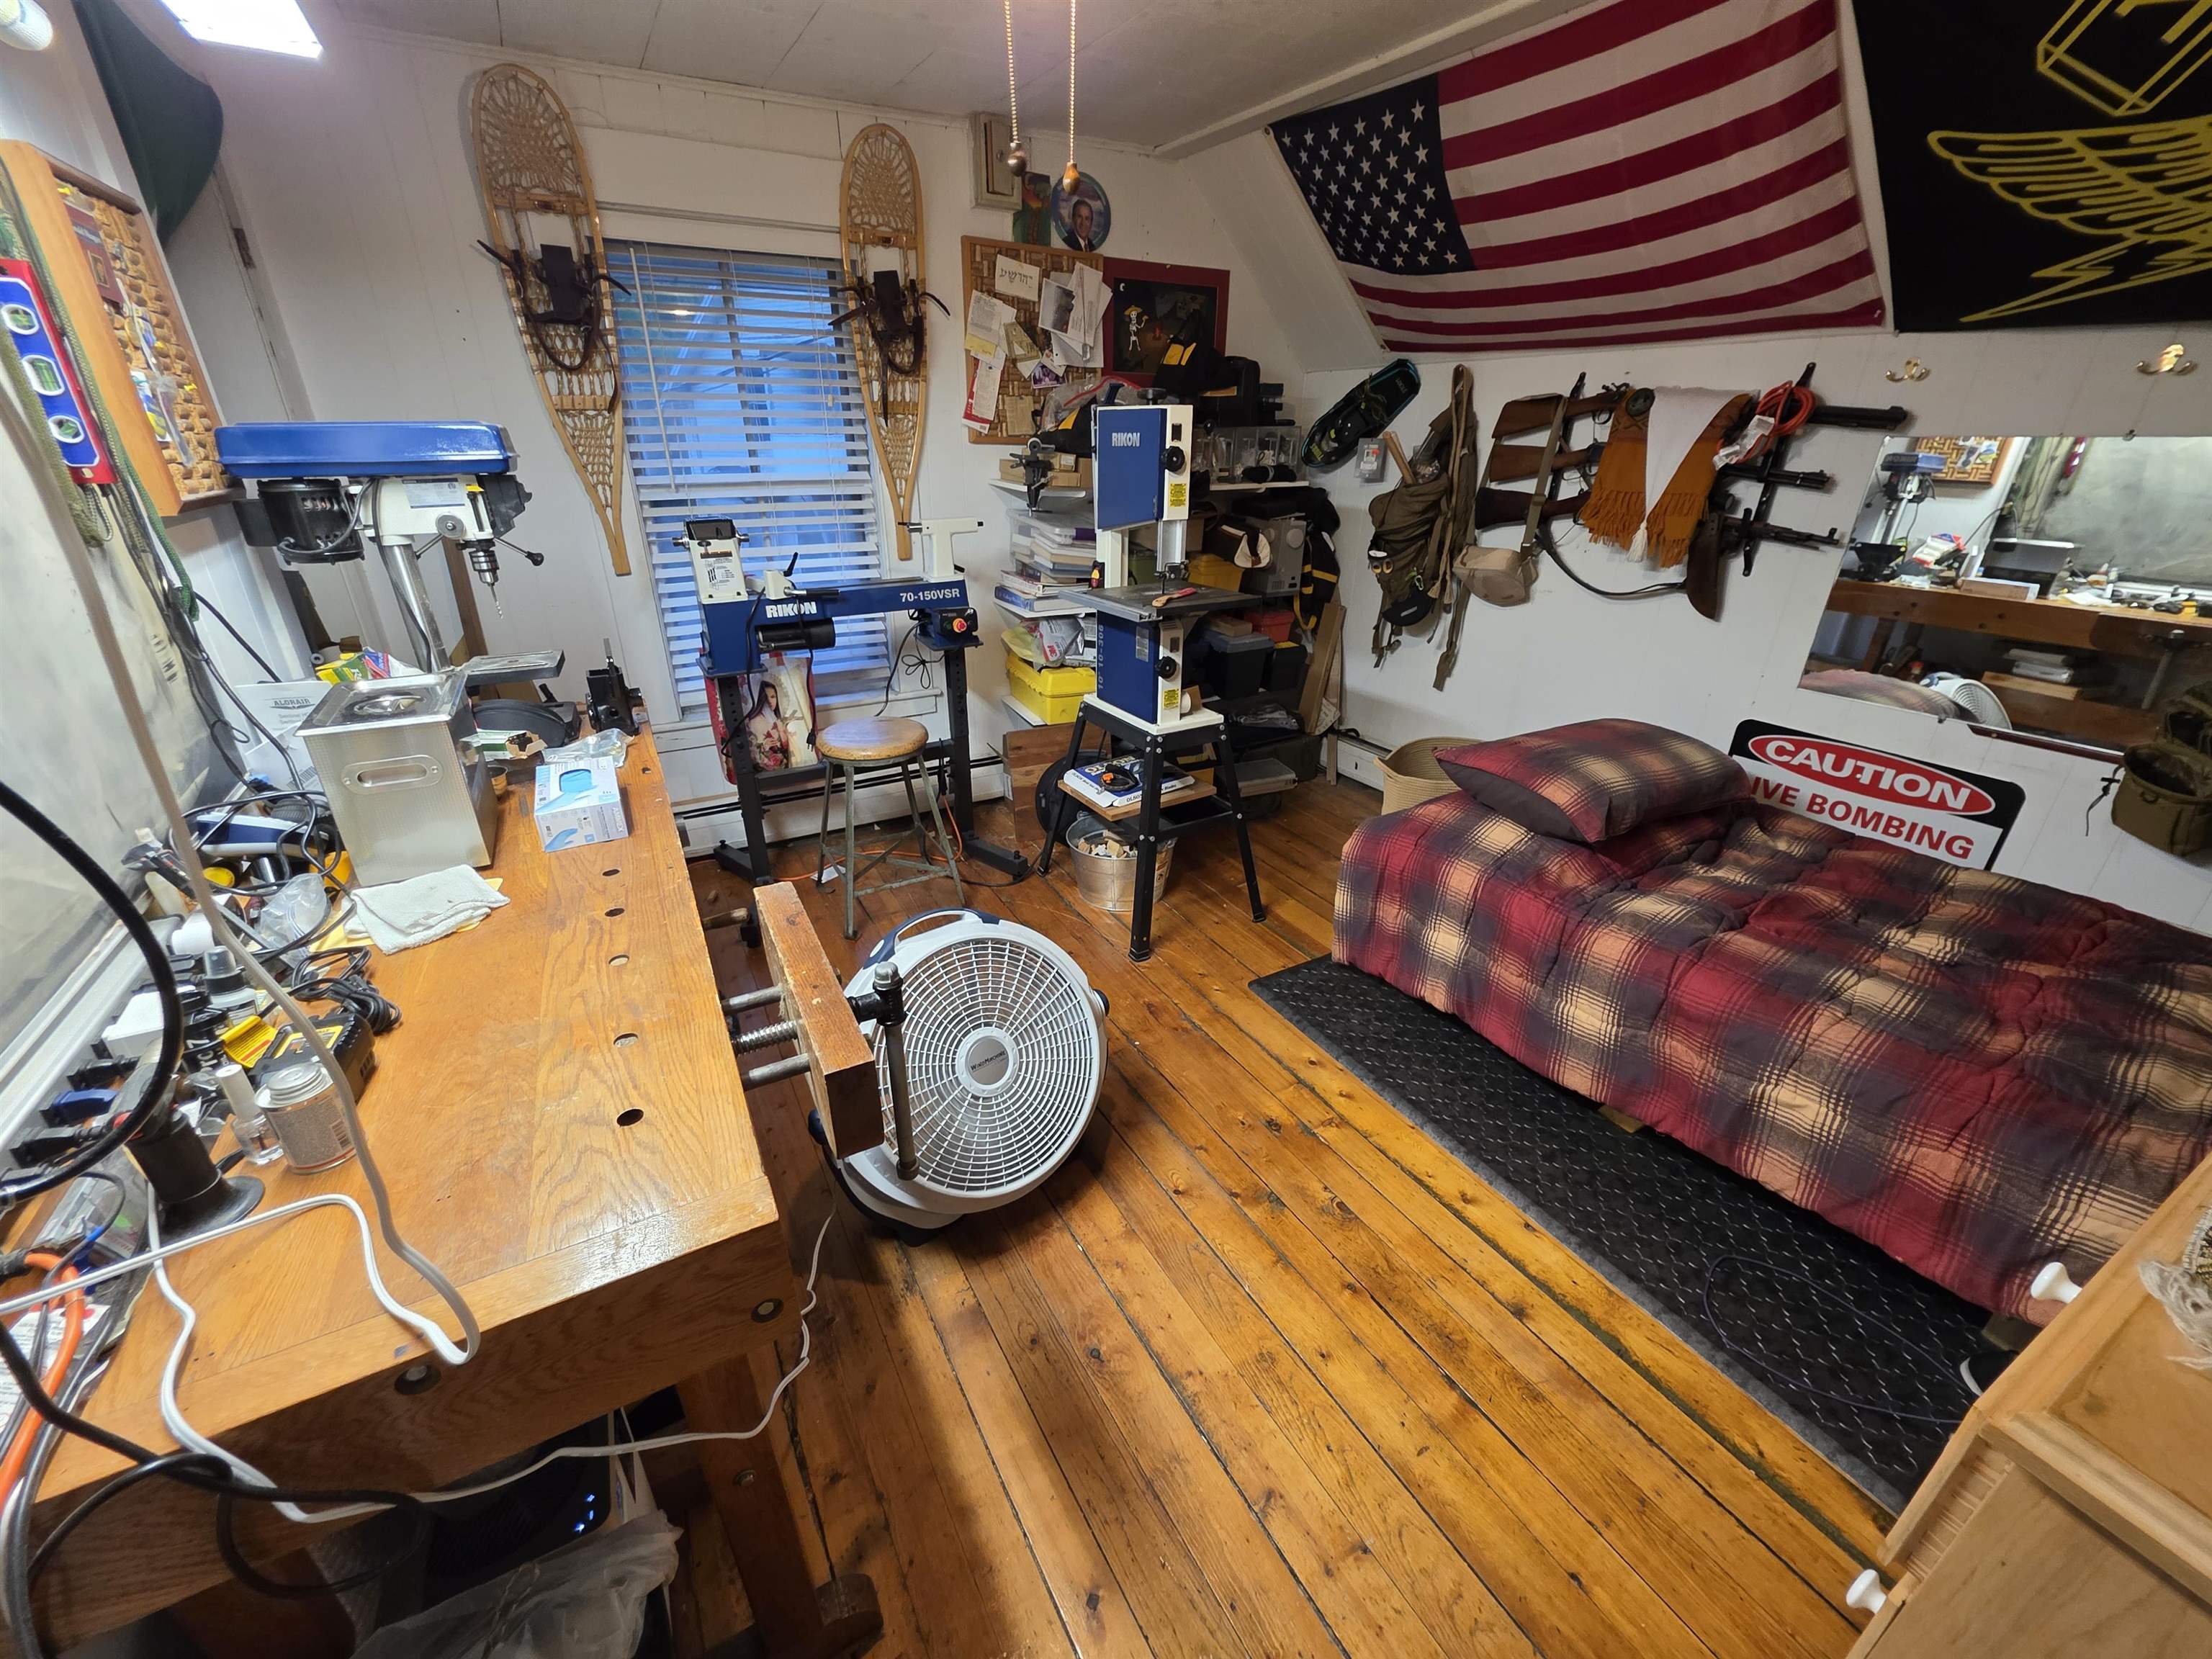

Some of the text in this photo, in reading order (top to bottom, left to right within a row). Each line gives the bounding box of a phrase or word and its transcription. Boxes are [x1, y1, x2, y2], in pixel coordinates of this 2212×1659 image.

[1111, 432, 1141, 447] RIKON
[899, 588, 961, 602] 70-150VSR
[765, 601, 817, 618] RIKON
[1084, 756, 1136, 775] OLON
[1765, 739, 1972, 811] CAUTION
[1750, 776, 1974, 860] IVE BOMBING
